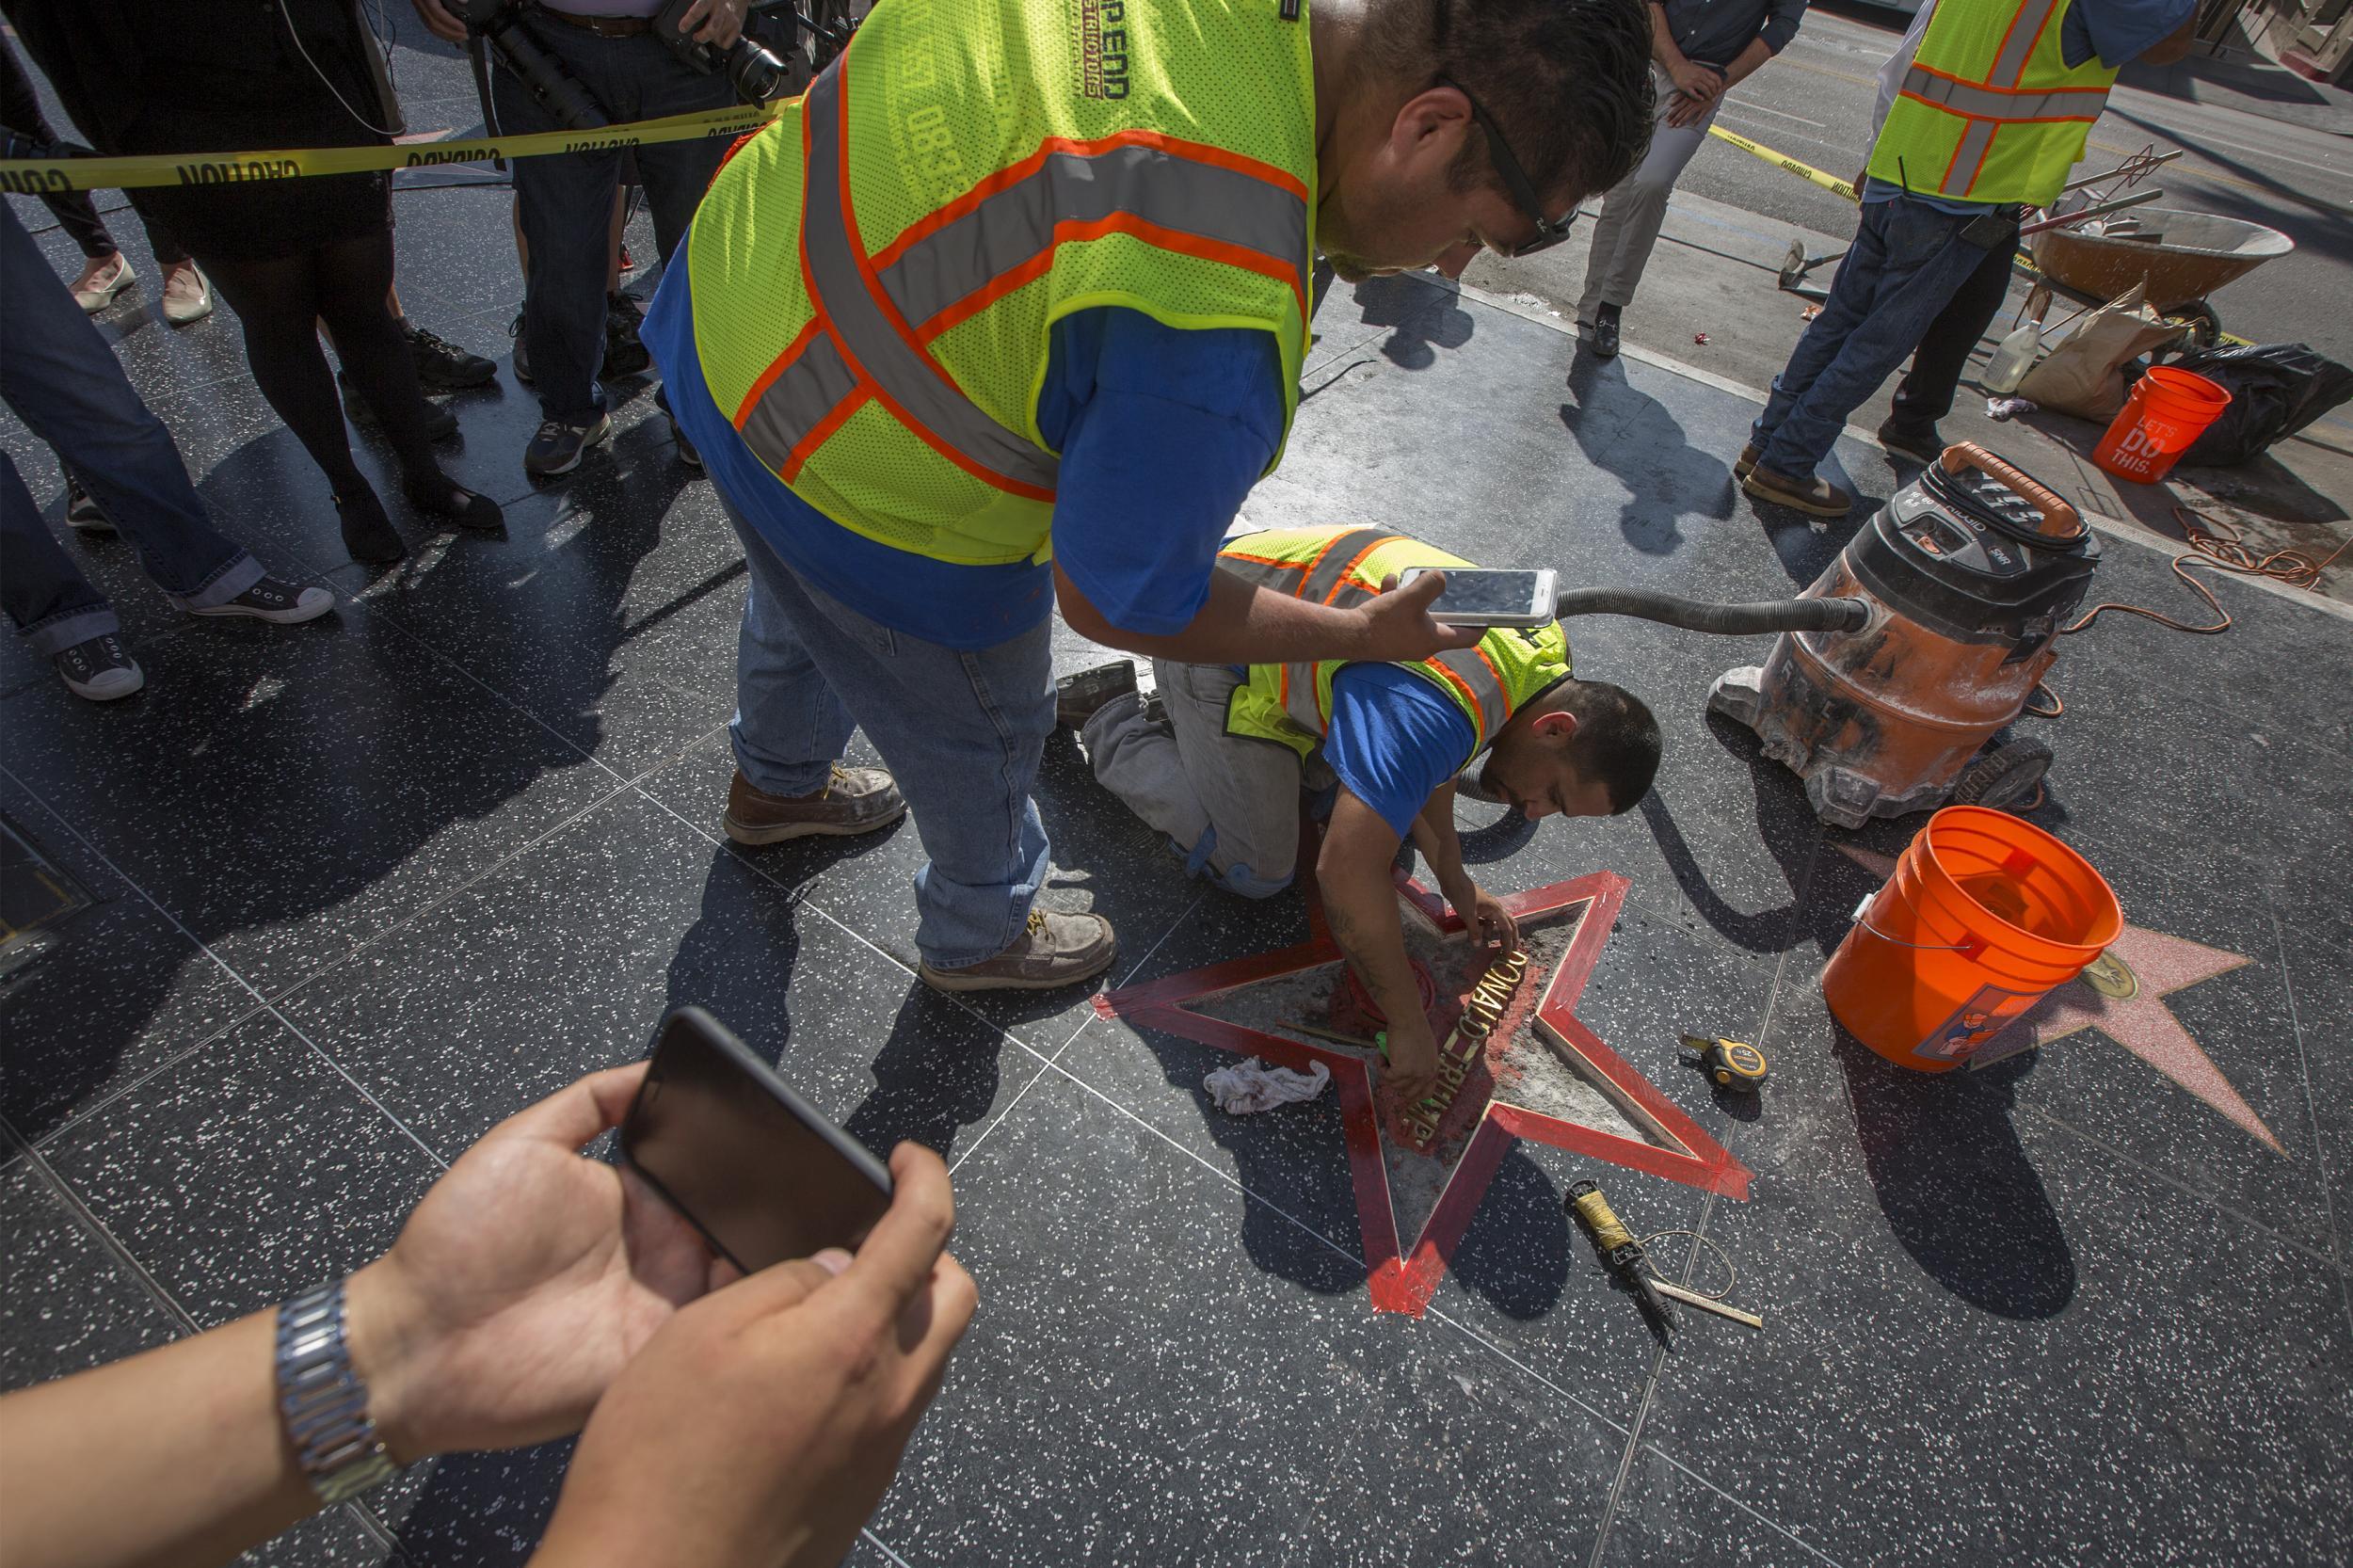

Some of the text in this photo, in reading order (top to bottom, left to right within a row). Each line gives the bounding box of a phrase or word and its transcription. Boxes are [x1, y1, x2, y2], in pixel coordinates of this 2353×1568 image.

[1102, 29, 1130, 100] END
[0, 168, 73, 193] CUI
[175, 159, 301, 186] CAUTION
[2137, 414, 2178, 438] LET'S
[2121, 427, 2167, 458] DO
[2111, 447, 2151, 474] THIS.
